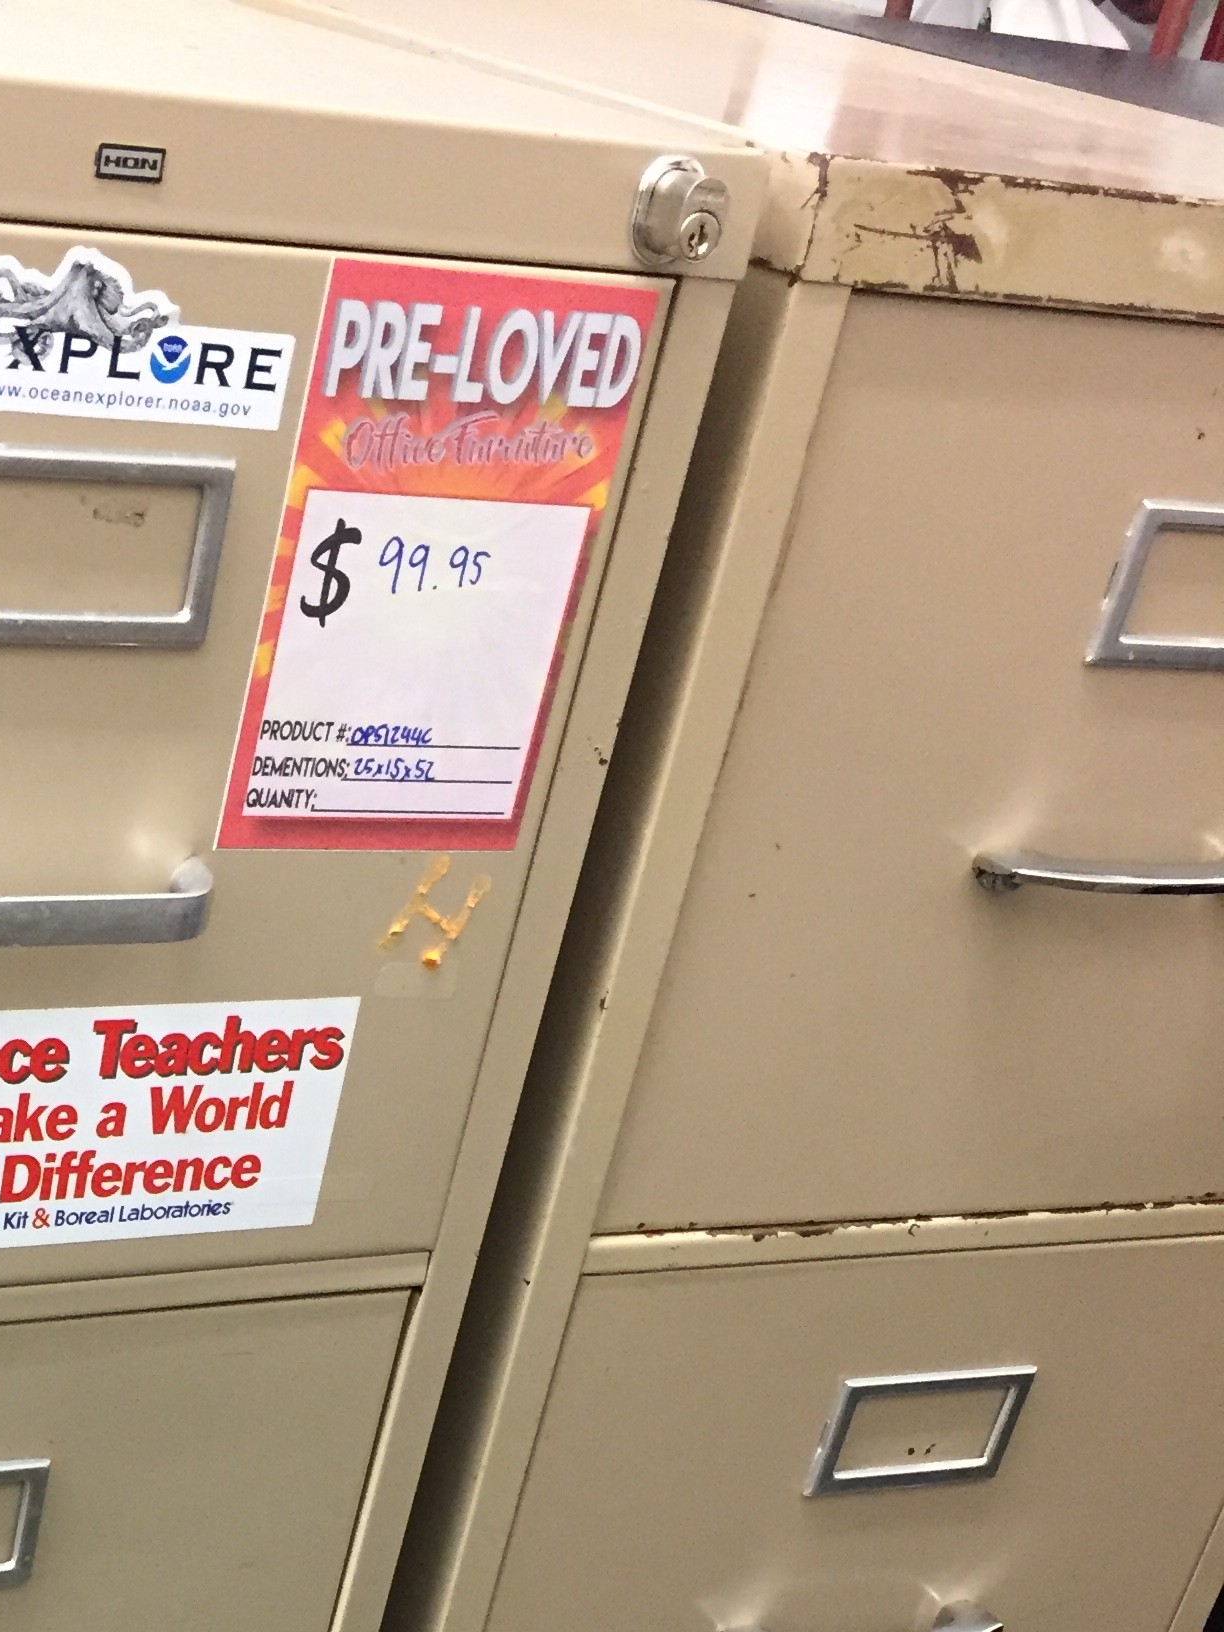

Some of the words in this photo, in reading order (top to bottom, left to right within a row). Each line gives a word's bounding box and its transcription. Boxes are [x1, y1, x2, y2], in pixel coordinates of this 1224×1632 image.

[103, 154, 158, 171] HON
[322, 298, 642, 408] PRE-LOVED
[343, 411, 447, 471] Office
[441, 409, 595, 467] Furniture
[299, 517, 363, 628] $
[259, 719, 335, 743] PRODUCT
[251, 756, 351, 780] DEMENTIONS:
[353, 757, 436, 782] 25x15x52
[92, 1015, 346, 1080] Teachers
[95, 1101, 128, 1139] a
[149, 1080, 295, 1136] World
[2, 1210, 30, 1231] Kit
[31, 1207, 51, 1230] &
[53, 1205, 115, 1227] Boreal
[117, 1199, 233, 1223] Laboratories
